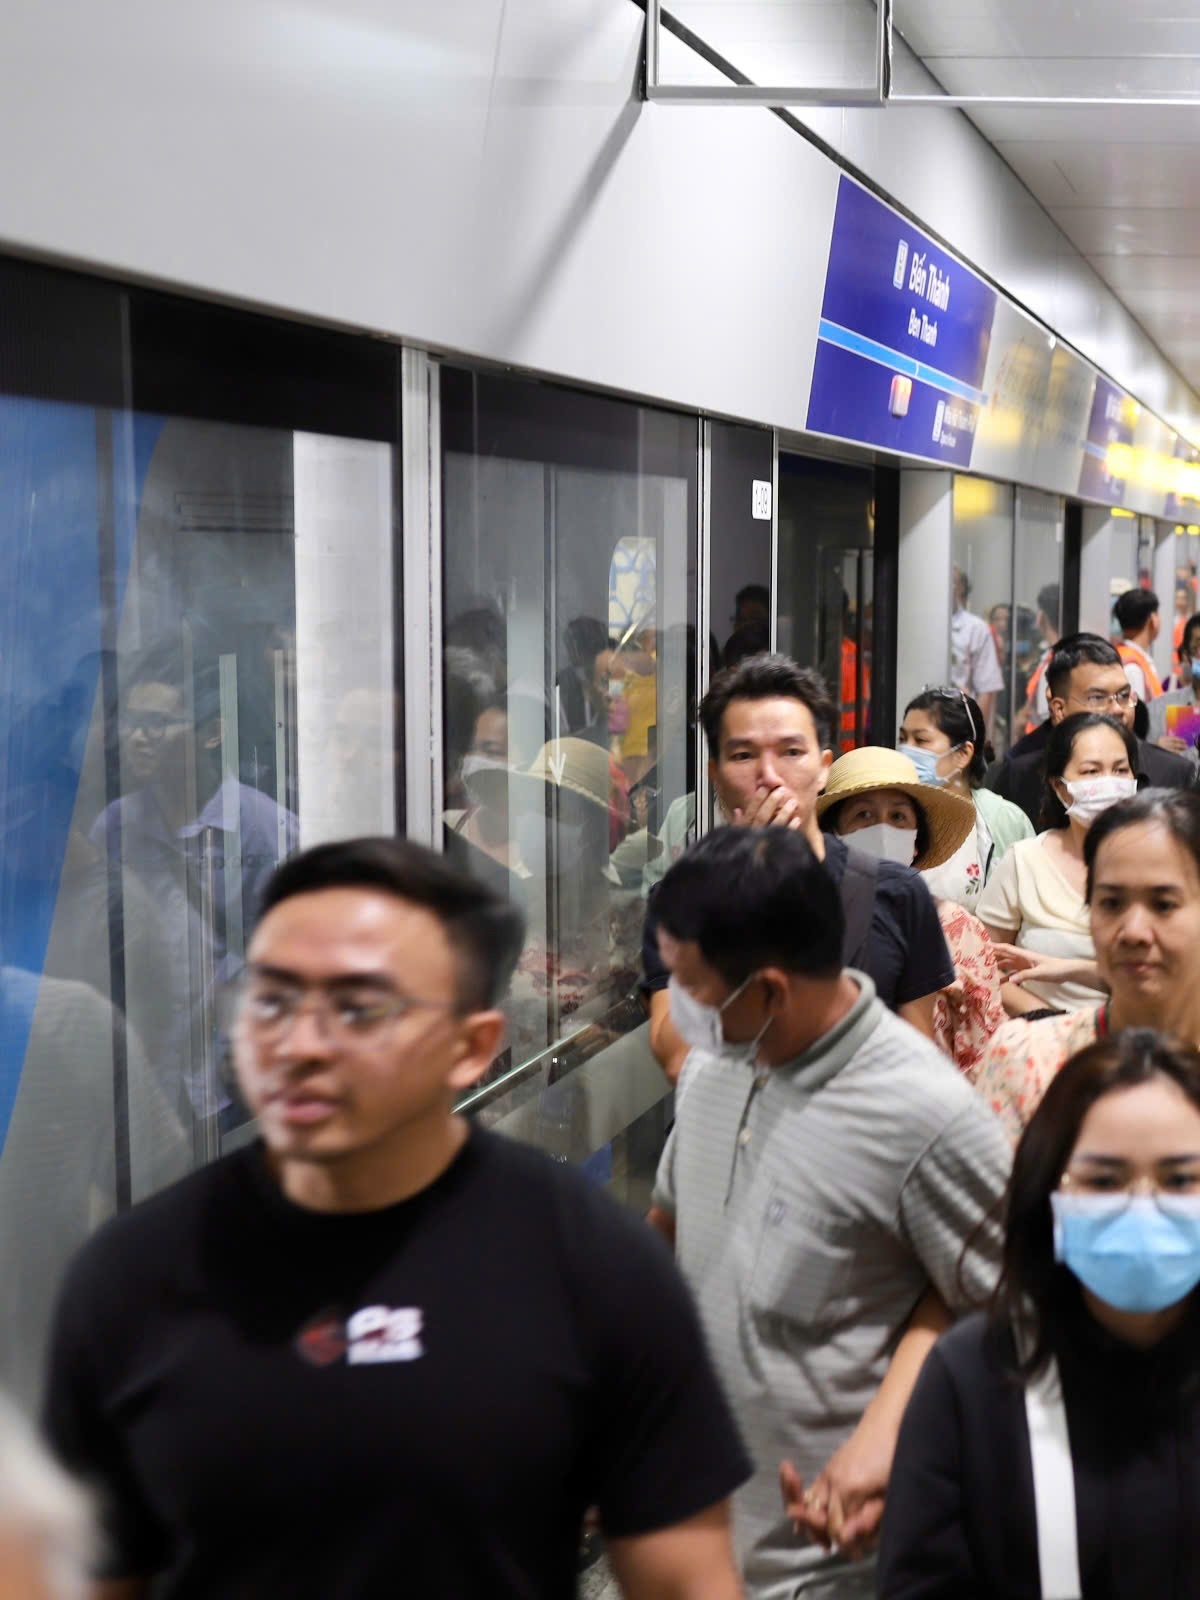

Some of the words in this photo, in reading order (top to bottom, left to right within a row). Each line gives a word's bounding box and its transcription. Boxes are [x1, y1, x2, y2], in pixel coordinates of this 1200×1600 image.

[908, 251, 927, 297] Bến
[926, 263, 950, 312] Thành
[907, 307, 921, 339] Ben
[920, 313, 938, 347] Thanh
